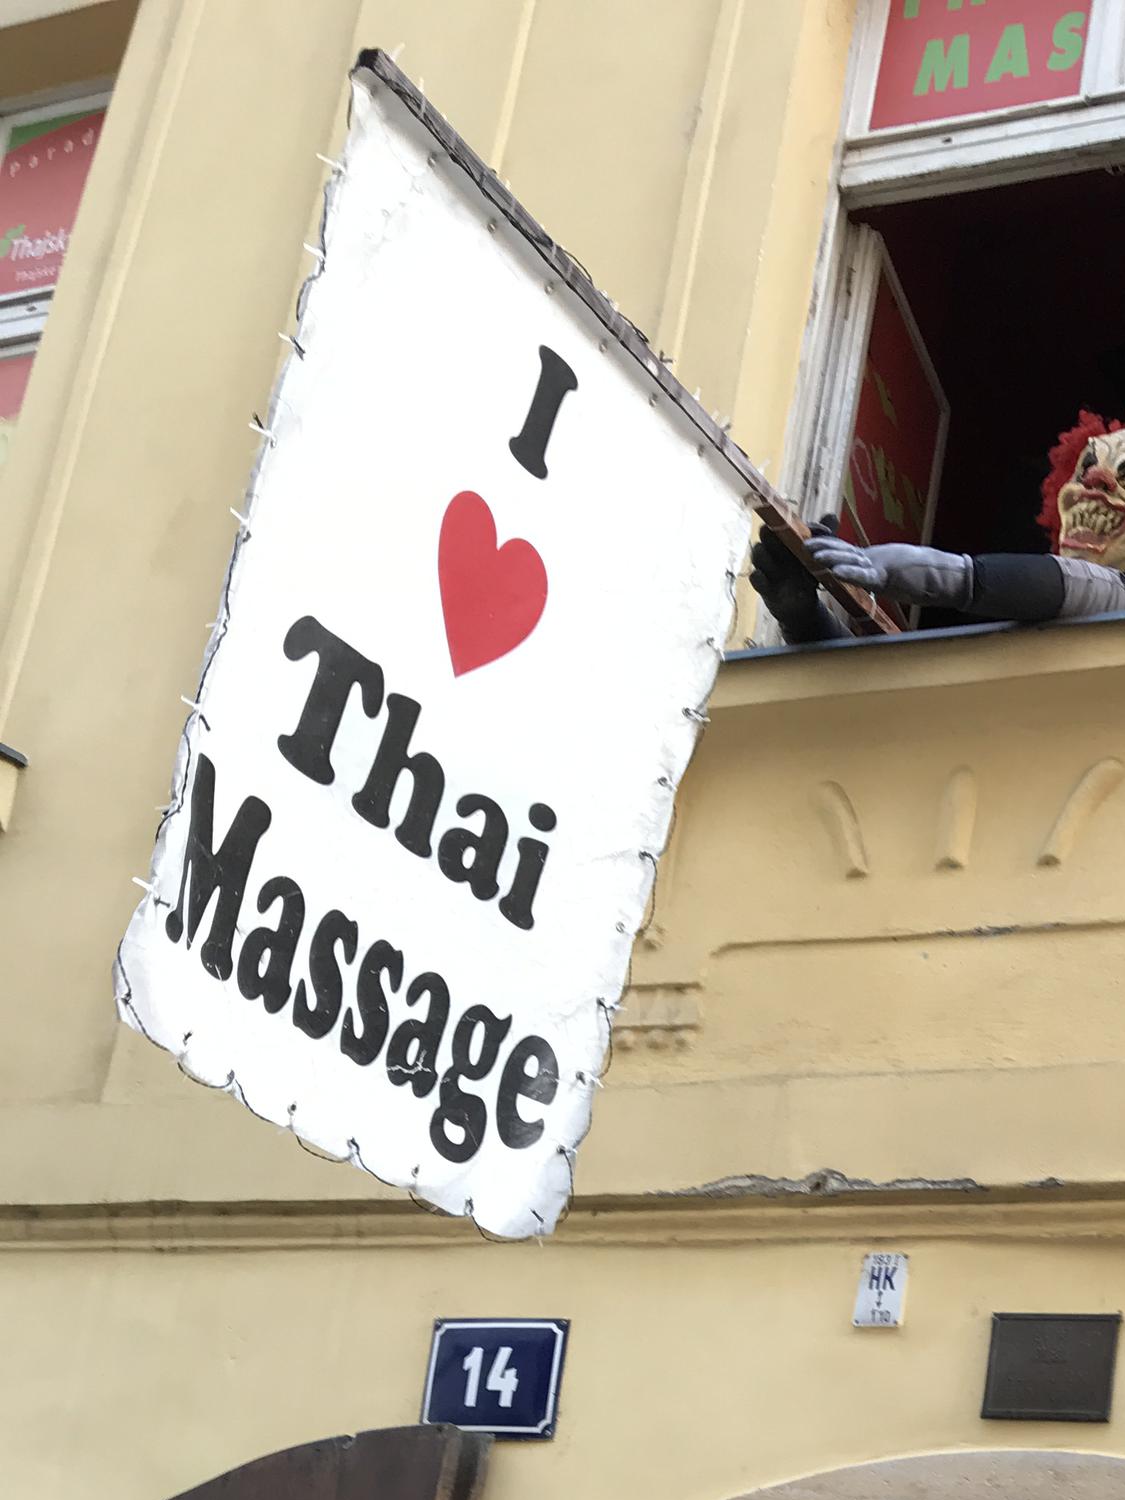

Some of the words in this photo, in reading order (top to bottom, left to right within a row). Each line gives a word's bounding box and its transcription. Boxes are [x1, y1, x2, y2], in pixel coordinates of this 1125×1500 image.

[509, 345, 579, 480] I
[277, 615, 557, 931] Thai
[165, 753, 558, 1163] Massage
[868, 1266, 898, 1291] HK
[462, 1346, 519, 1408] 14
